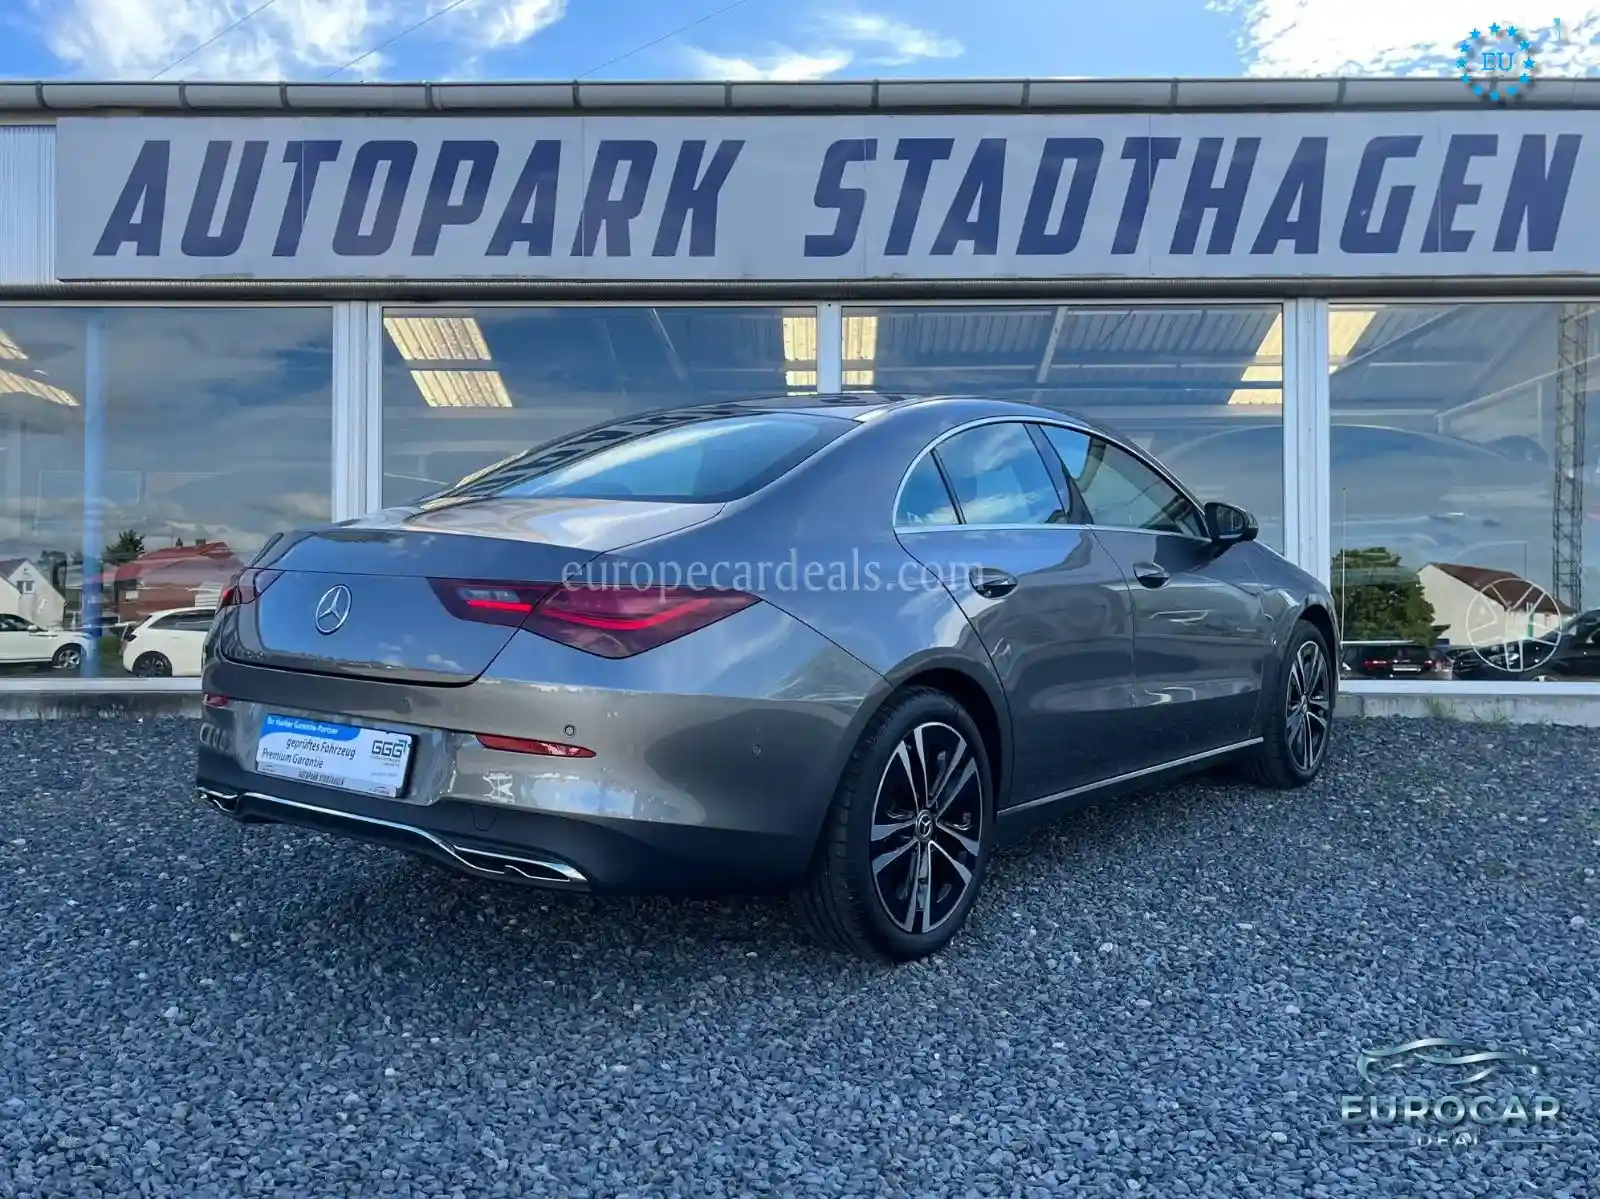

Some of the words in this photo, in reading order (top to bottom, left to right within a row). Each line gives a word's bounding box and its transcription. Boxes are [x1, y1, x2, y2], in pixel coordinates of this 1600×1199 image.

[93, 140, 745, 257] AUTOPARK
[804, 134, 1583, 257] STADTHAGEN
[261, 747, 292, 763] Premium
[292, 753, 324, 769] Garantie
[286, 737, 321, 752] geprüftes
[320, 741, 356, 760] Fahrzeug
[371, 740, 403, 758] GGG
